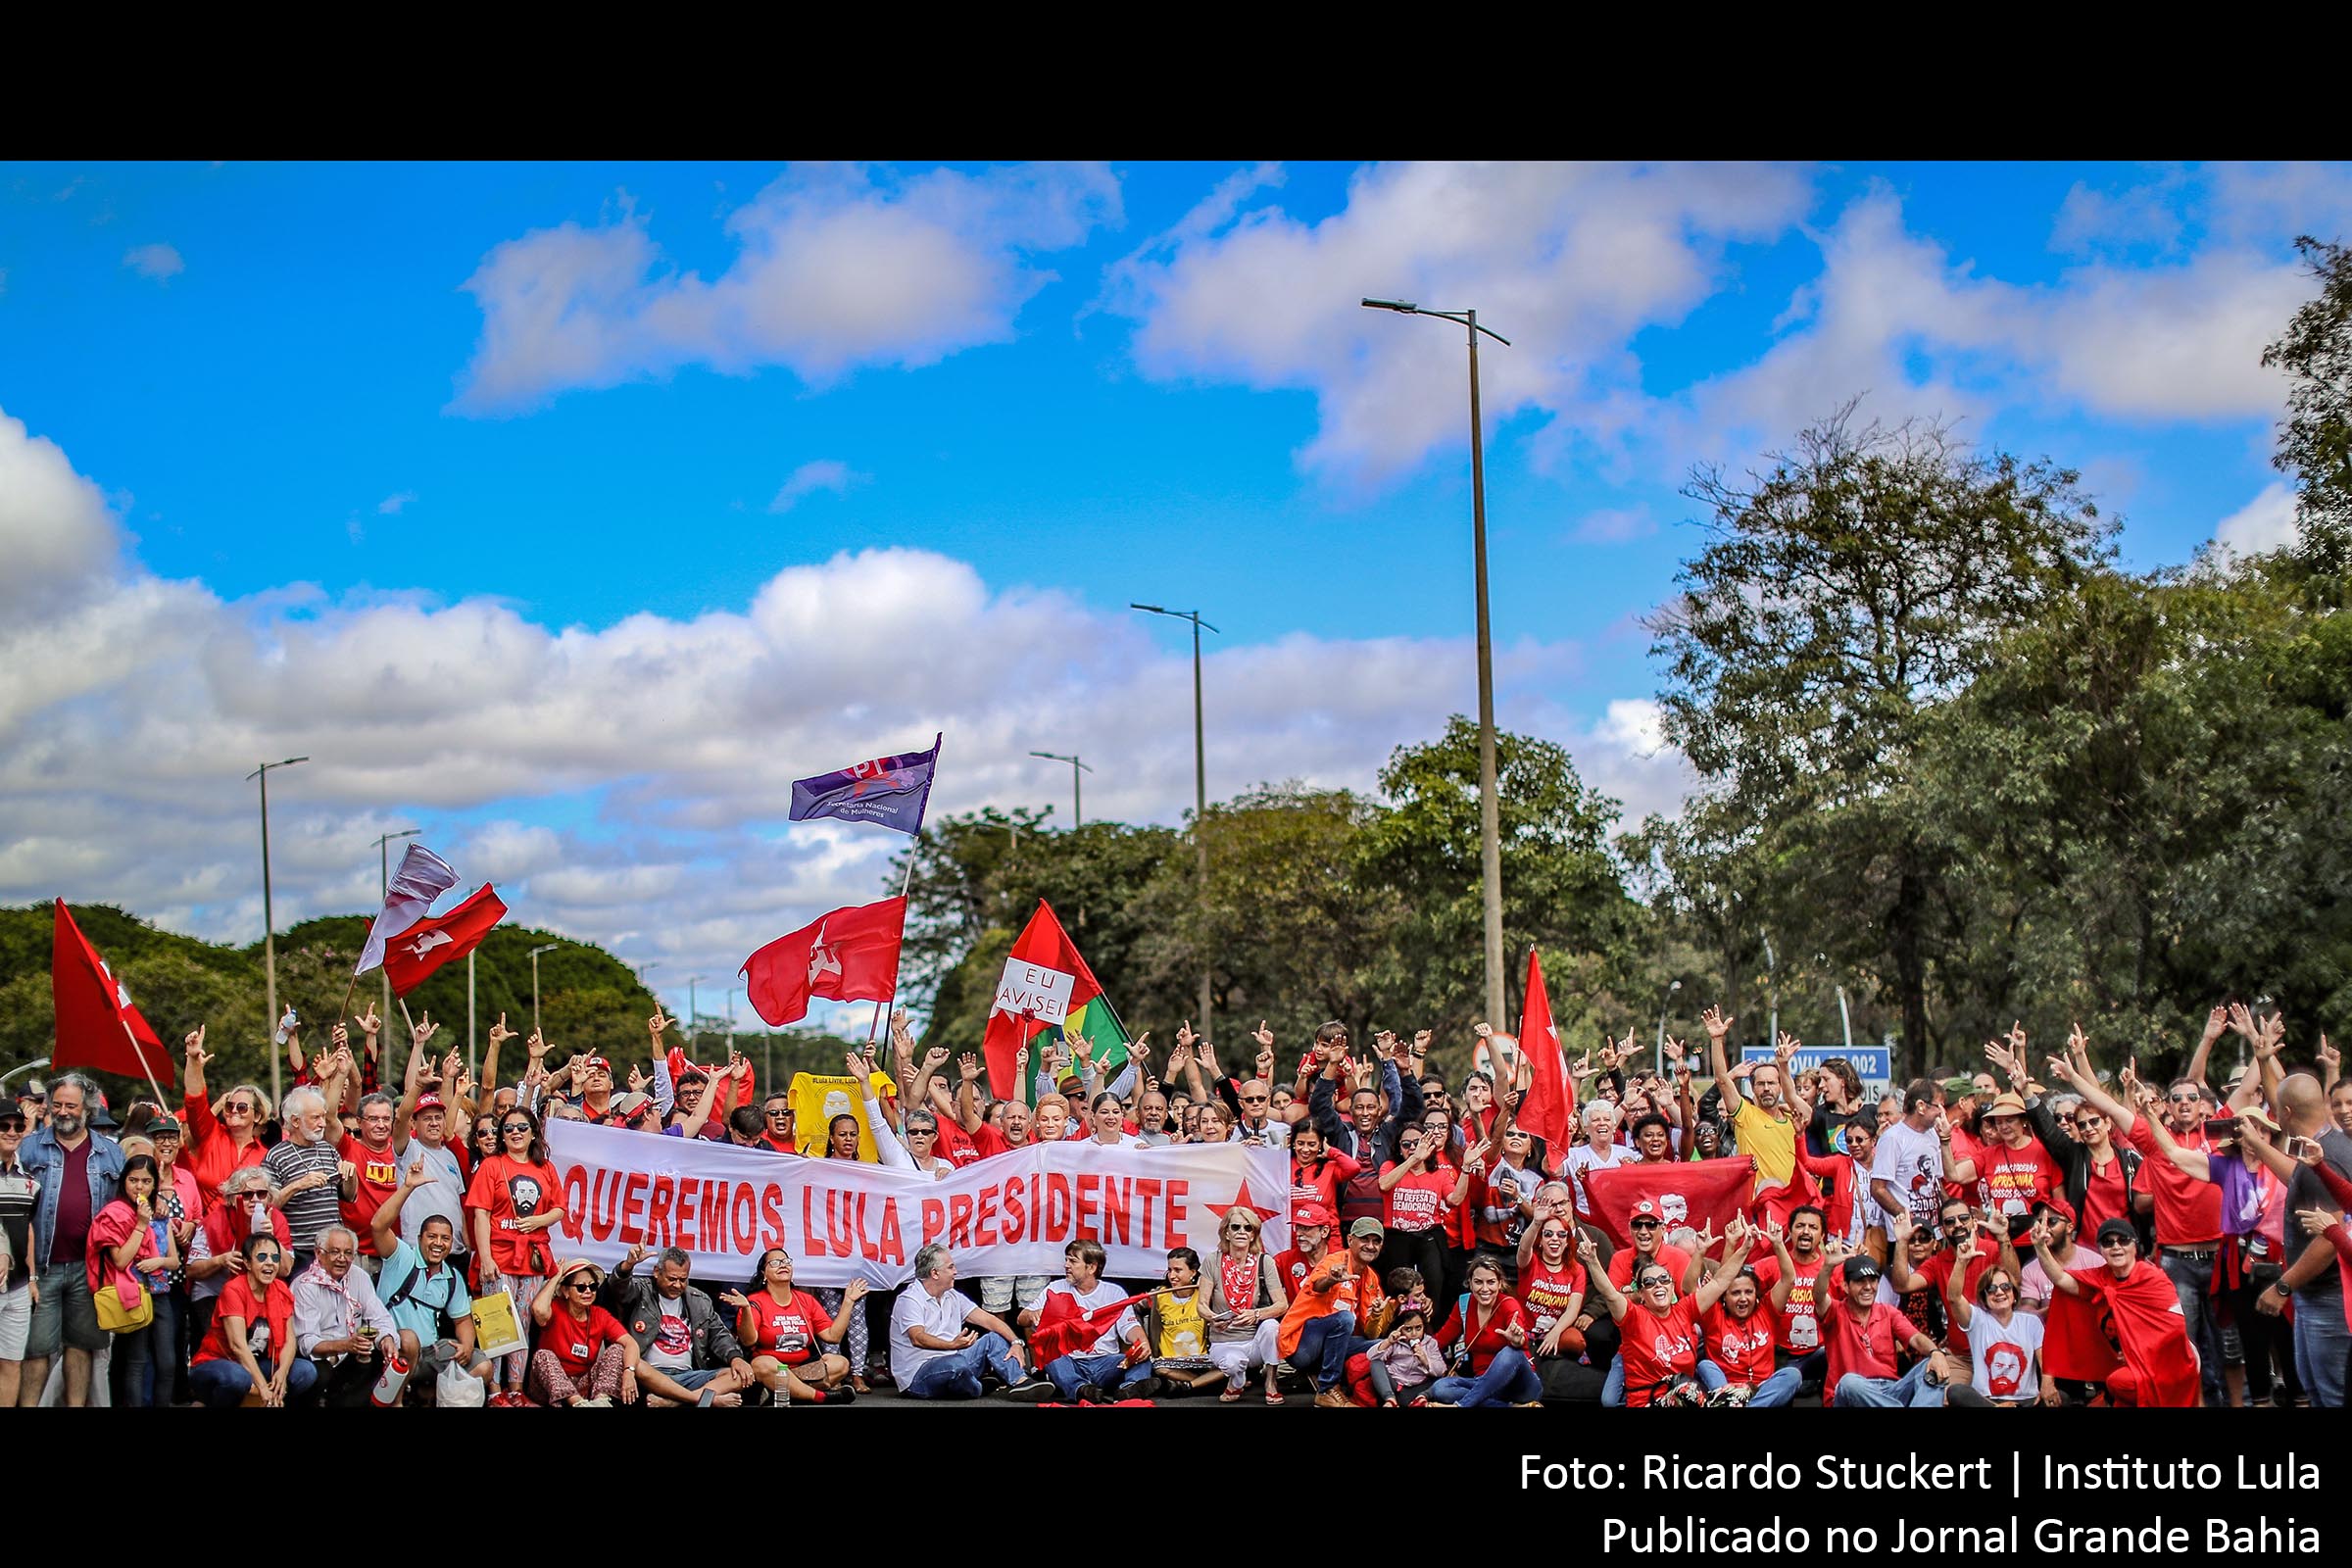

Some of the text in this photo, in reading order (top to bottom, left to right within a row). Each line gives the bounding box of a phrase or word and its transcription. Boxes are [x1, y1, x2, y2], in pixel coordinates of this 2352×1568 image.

[851, 808, 885, 818] Mulheres
[864, 801, 899, 814] Nacional
[1025, 968, 1055, 989] EU
[999, 987, 1063, 1016] AVISEI
[1394, 1192, 1404, 1201] EM
[1404, 1193, 1429, 1203] DEFESA
[560, 1164, 1189, 1266] QUEREMOS LULA PRESIDENTE
[1393, 1200, 1436, 1215] DEMOCRACIA
